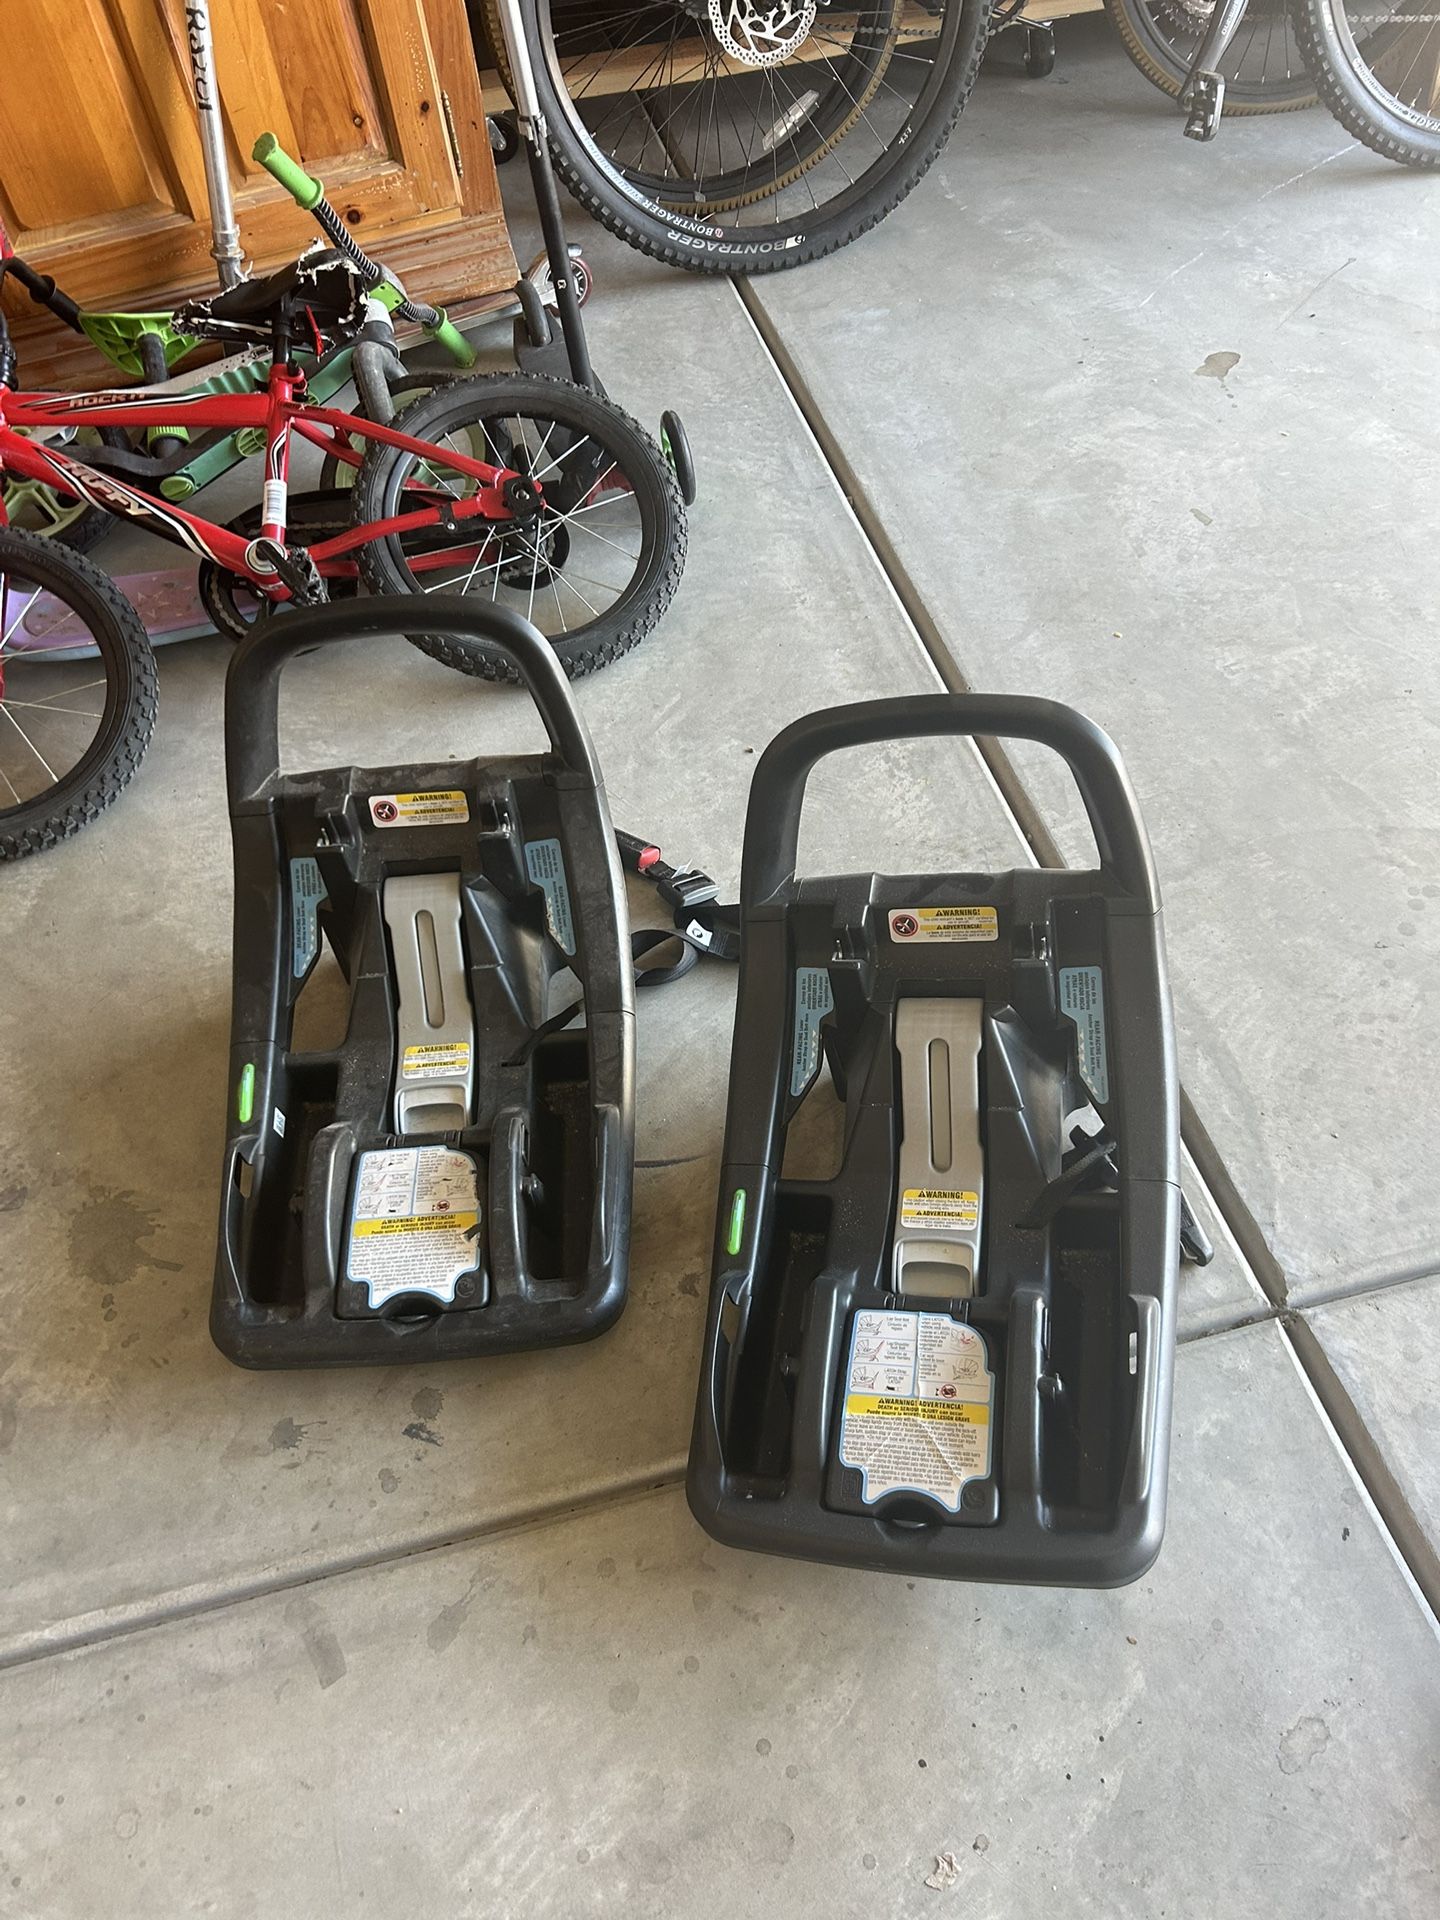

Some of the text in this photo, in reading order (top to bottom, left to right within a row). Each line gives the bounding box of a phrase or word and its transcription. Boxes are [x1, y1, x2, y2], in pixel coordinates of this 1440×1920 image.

[642, 200, 715, 237] BONTRAGER
[667, 229, 787, 254] BONTRAGER
[419, 793, 452, 801] WARNING!
[943, 909, 981, 917] WARNING!
[424, 1044, 457, 1053] WARNING!
[926, 1191, 963, 1199] WARNING!
[387, 1216, 416, 1224] WARNING!
[885, 1398, 963, 1410] WARNING! ADVERTENCIA!
